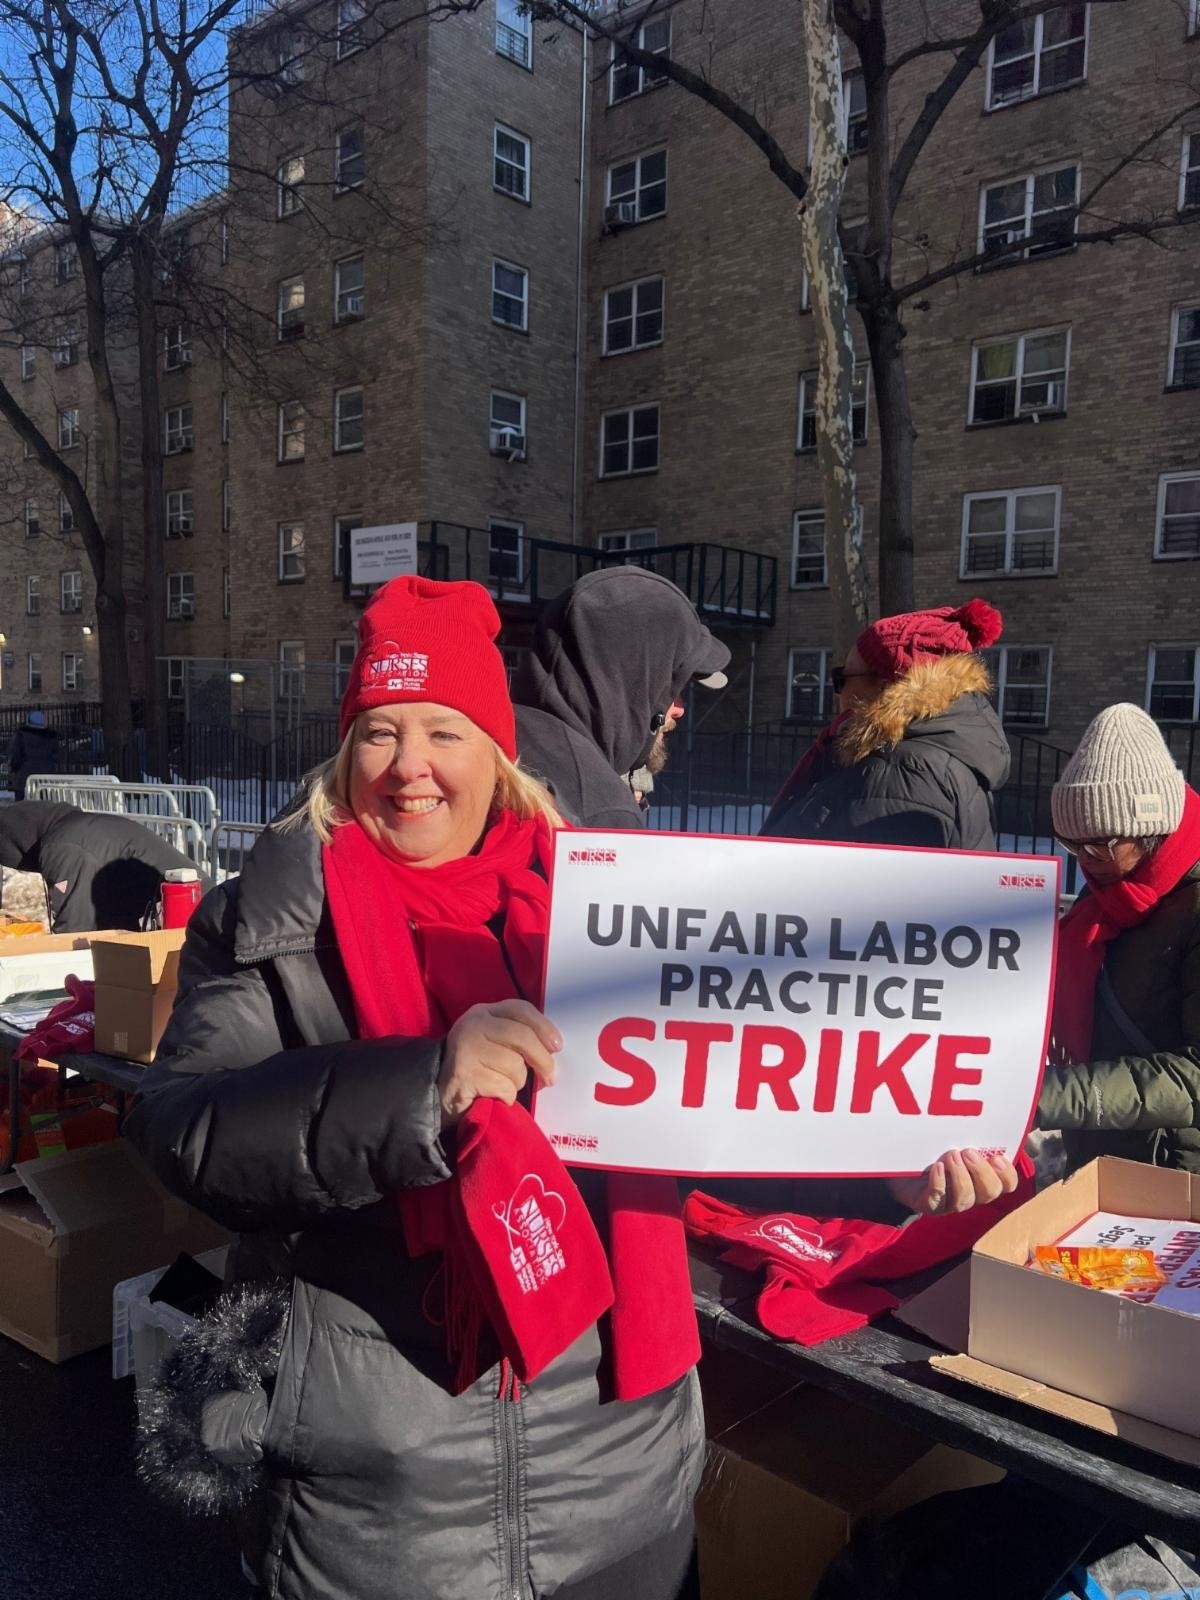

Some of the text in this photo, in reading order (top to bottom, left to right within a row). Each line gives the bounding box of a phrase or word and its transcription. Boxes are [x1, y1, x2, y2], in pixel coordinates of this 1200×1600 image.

[371, 658, 428, 673] NURSES
[568, 850, 617, 863] NURSES
[998, 875, 1045, 888] NURSES
[587, 903, 1021, 972] UNFAIR LABOR
[659, 962, 944, 1022] PRACTICE
[594, 1016, 992, 1118] STRIKE
[550, 1135, 599, 1149] NURSES
[519, 1195, 561, 1278] NURSES
